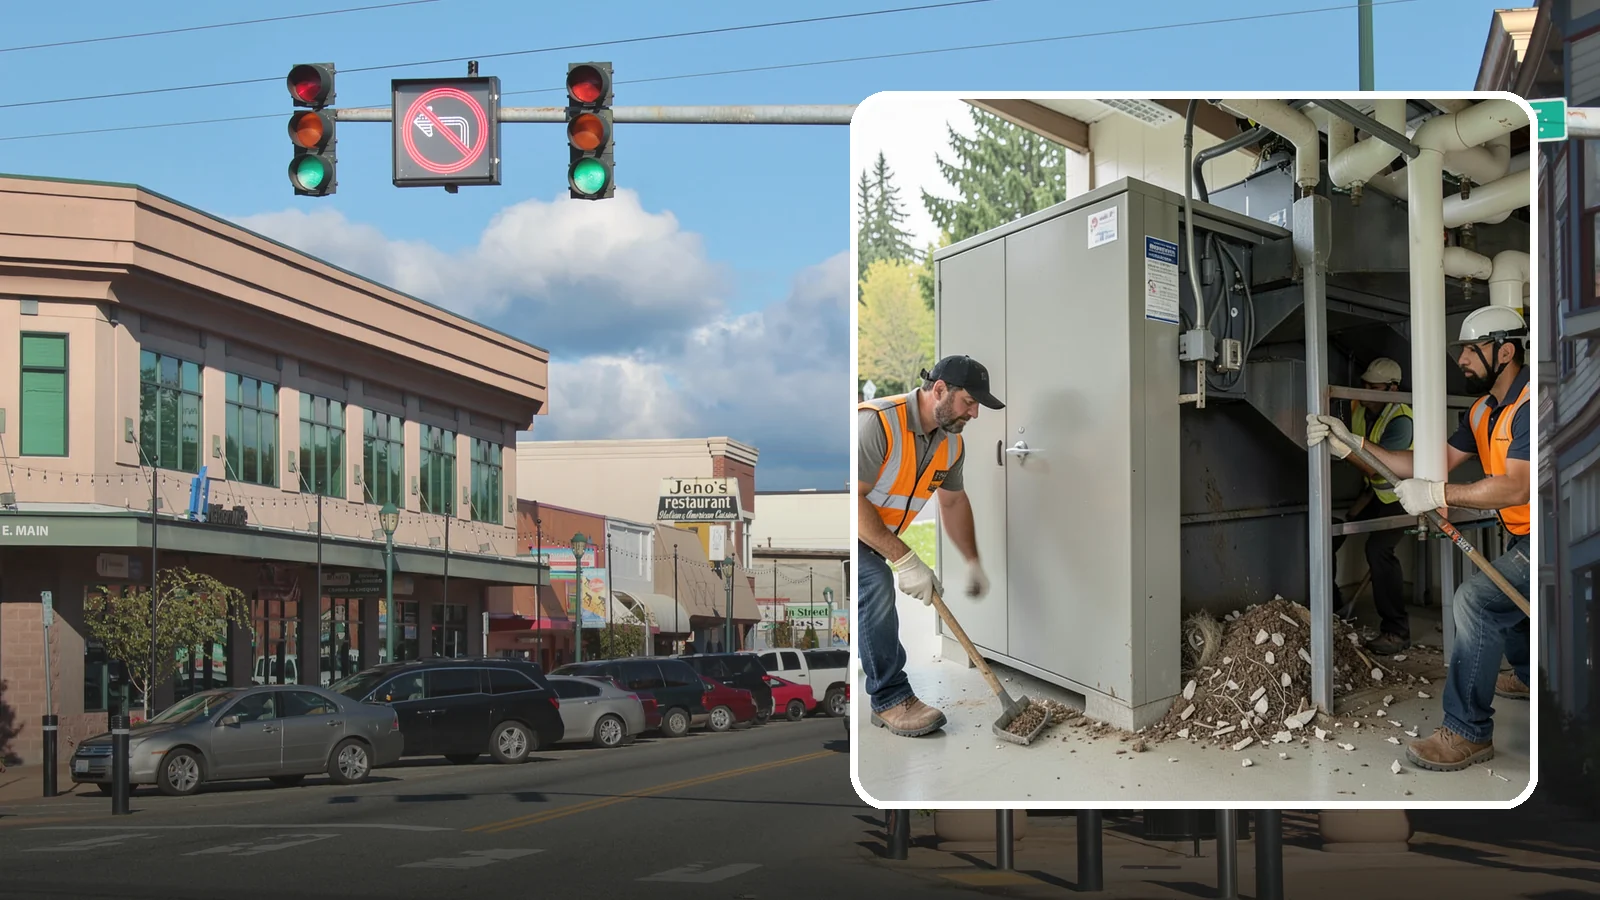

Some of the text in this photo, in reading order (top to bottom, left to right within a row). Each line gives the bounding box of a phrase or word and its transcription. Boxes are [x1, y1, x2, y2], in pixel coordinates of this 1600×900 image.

[669, 480, 727, 495] Jeno's
[665, 496, 731, 509] restaurant
[658, 510, 681, 519] Italian
[686, 509, 715, 519] American
[715, 509, 738, 519] Cuisine
[2, 525, 49, 536] E. MAIN
[797, 607, 828, 617] Street
